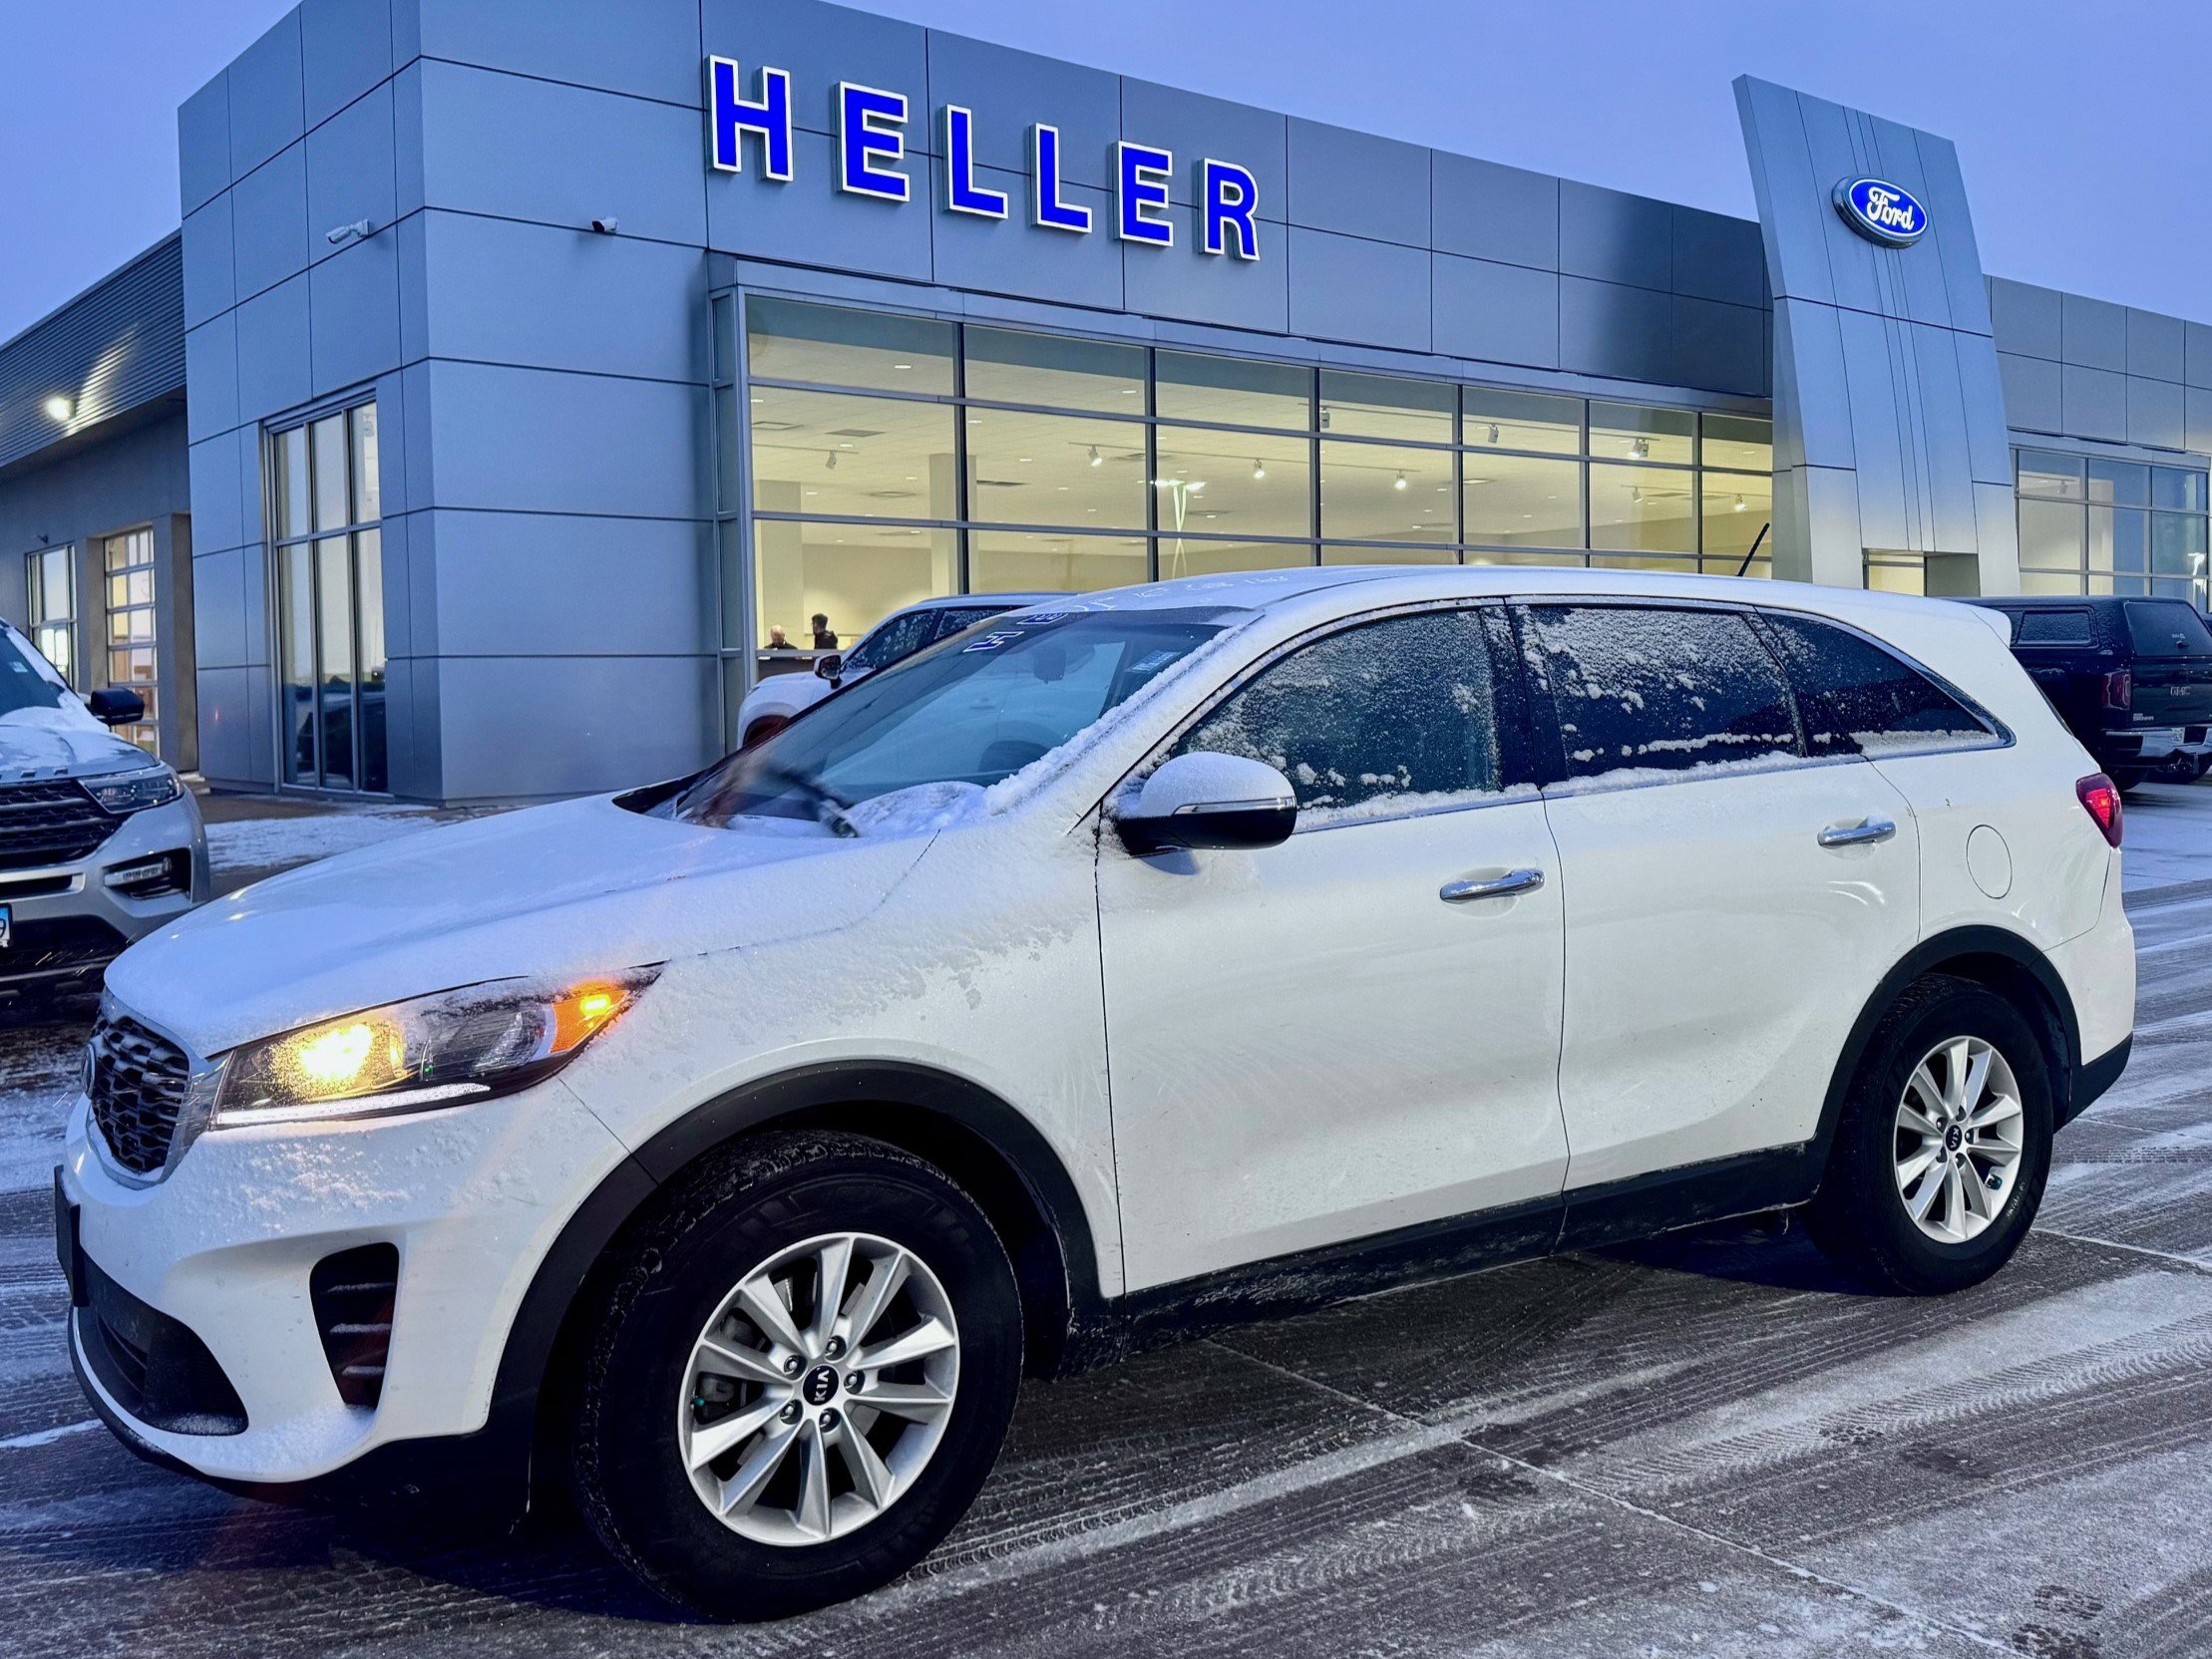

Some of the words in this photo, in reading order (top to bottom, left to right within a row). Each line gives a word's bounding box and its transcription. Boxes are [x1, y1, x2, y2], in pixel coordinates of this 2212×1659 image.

[706, 54, 1261, 260] HELLER
[1866, 185, 1915, 230] Ford
[1950, 1128, 1960, 1149] KIA
[814, 1369, 830, 1402] KIA
